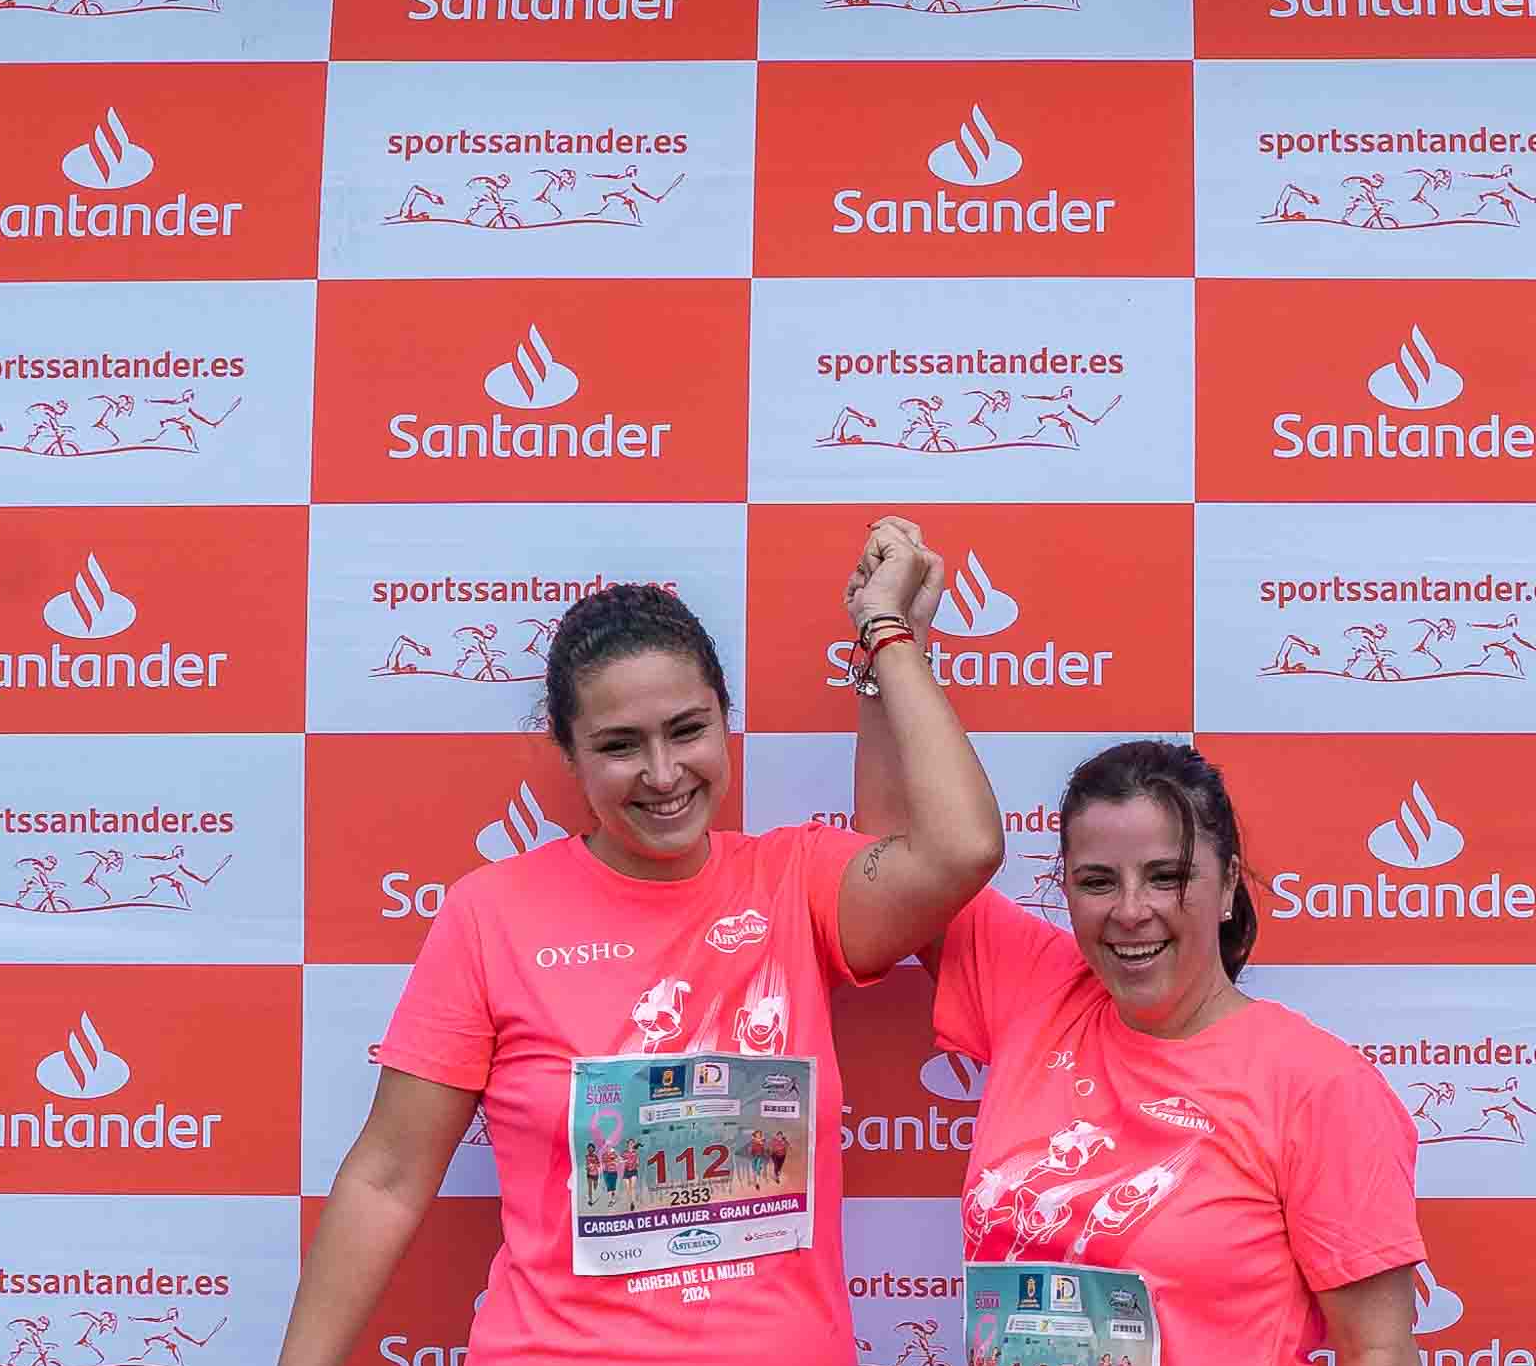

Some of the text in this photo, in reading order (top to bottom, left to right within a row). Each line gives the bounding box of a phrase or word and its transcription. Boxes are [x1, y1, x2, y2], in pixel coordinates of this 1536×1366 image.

[387, 127, 688, 163] sportssantander.es
[833, 189, 1116, 234] Santander
[817, 346, 1124, 382] sportssantander.es
[388, 413, 672, 459] Santander
[825, 641, 1113, 688] Stander
[536, 941, 636, 968] OYSHO
[647, 1144, 731, 1185] 112
[670, 1187, 711, 1206] 2353
[584, 1202, 800, 1234] CARRERA DE LA MUJER GRAN CANARIA
[600, 1248, 642, 1262] OYSHO
[627, 1261, 755, 1294] CARRERA DE LA MUJER
[682, 1287, 711, 1304] 2024
